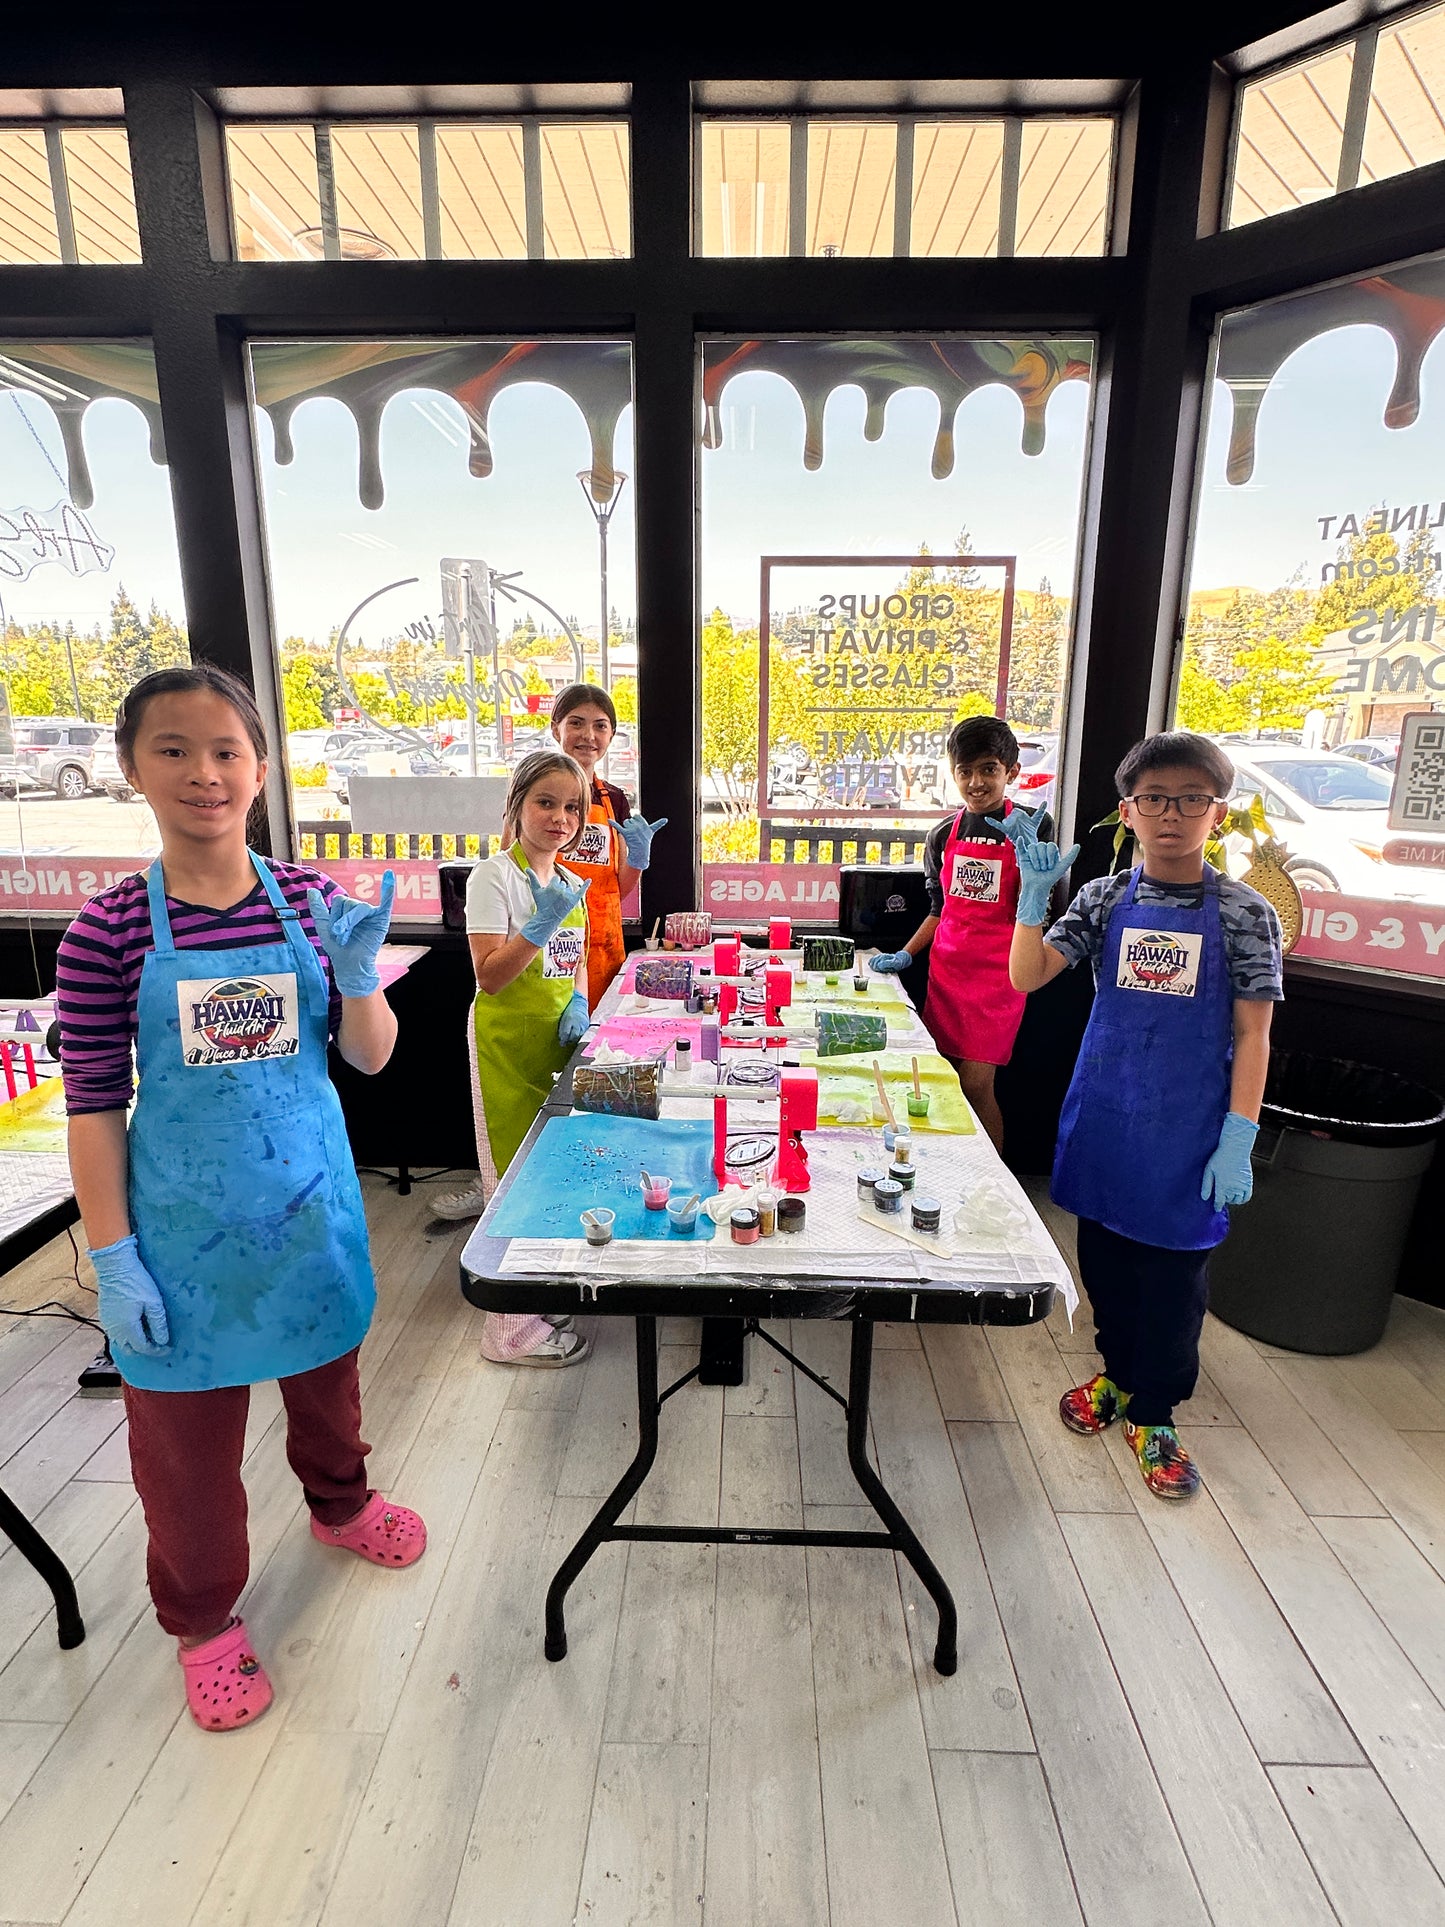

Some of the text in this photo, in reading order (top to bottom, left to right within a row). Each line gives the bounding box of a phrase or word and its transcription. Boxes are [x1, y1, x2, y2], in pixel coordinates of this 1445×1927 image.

[957, 866, 995, 884] HAWAII
[1126, 944, 1189, 968] HAWAII
[192, 996, 285, 1030] HAWAII
[213, 1018, 270, 1039] Fluid Art
[186, 1047, 201, 1064] A
[202, 1046, 237, 1063] Place
